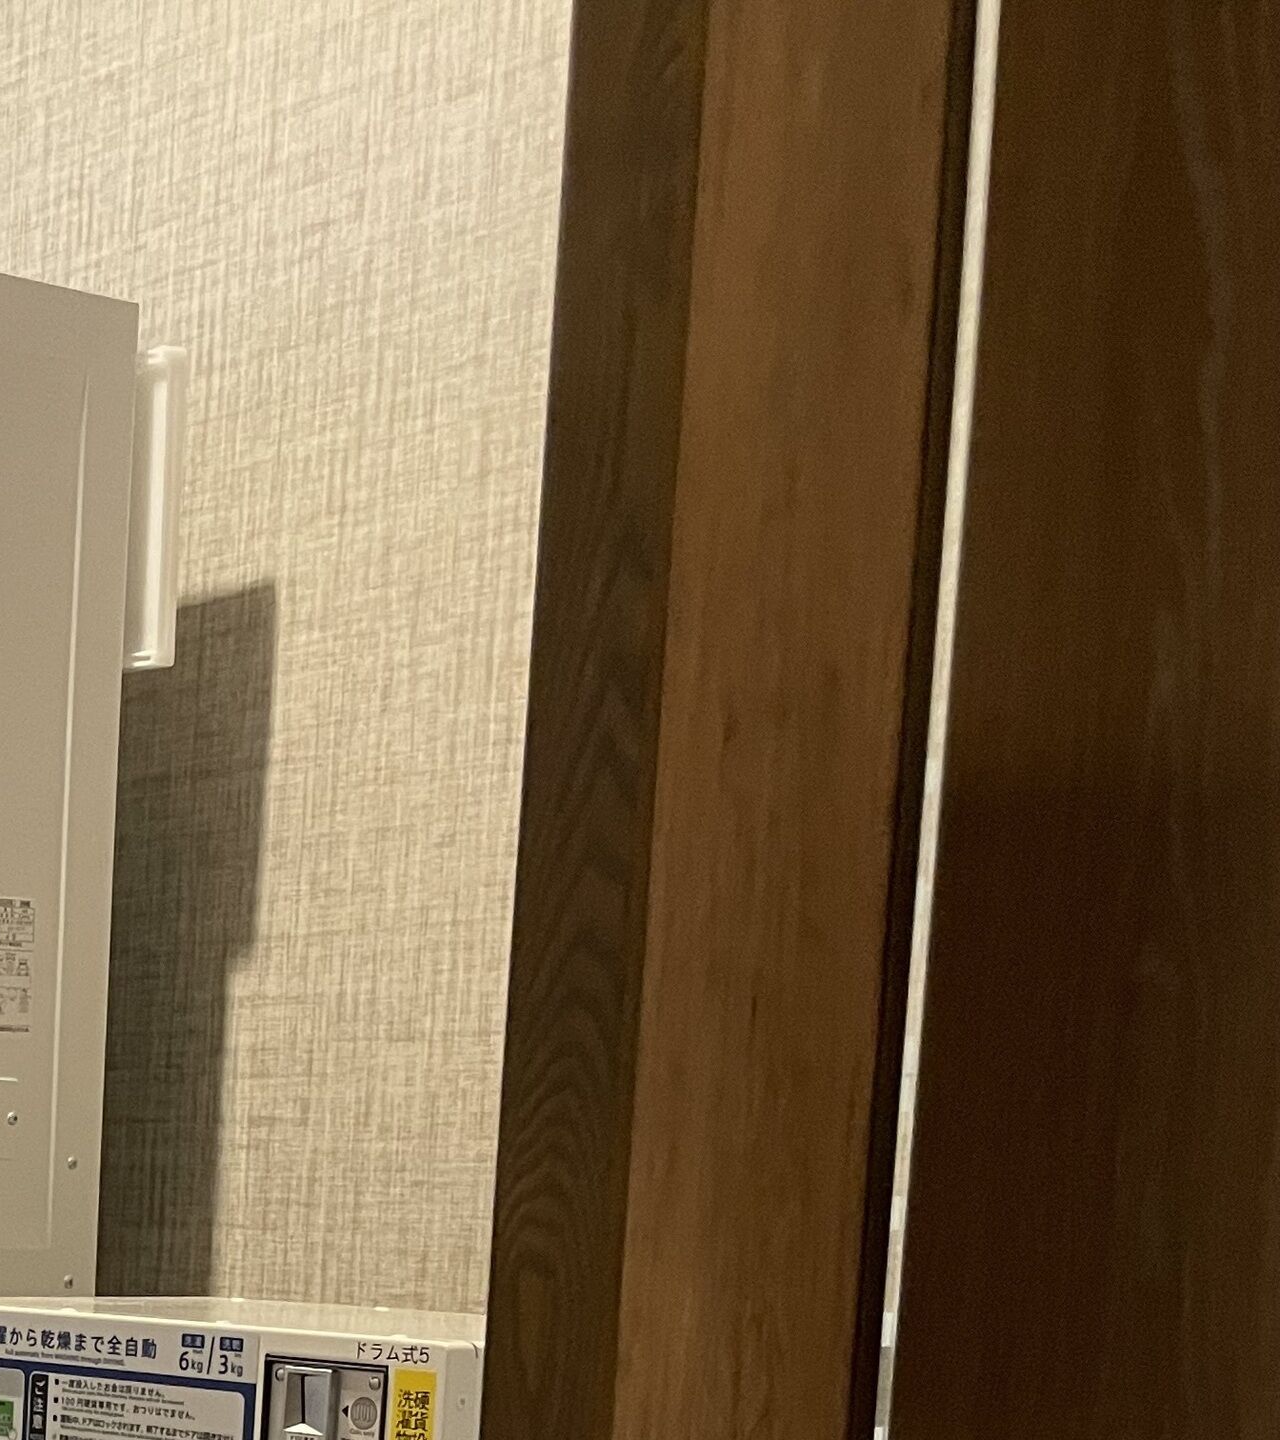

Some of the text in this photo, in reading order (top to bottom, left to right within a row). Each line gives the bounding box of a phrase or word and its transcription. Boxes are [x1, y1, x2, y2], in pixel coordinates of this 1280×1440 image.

[179, 1351, 204, 1373] 6kg
[357, 1341, 430, 1364] ドラム式5
[218, 1354, 243, 1378] 3kg
